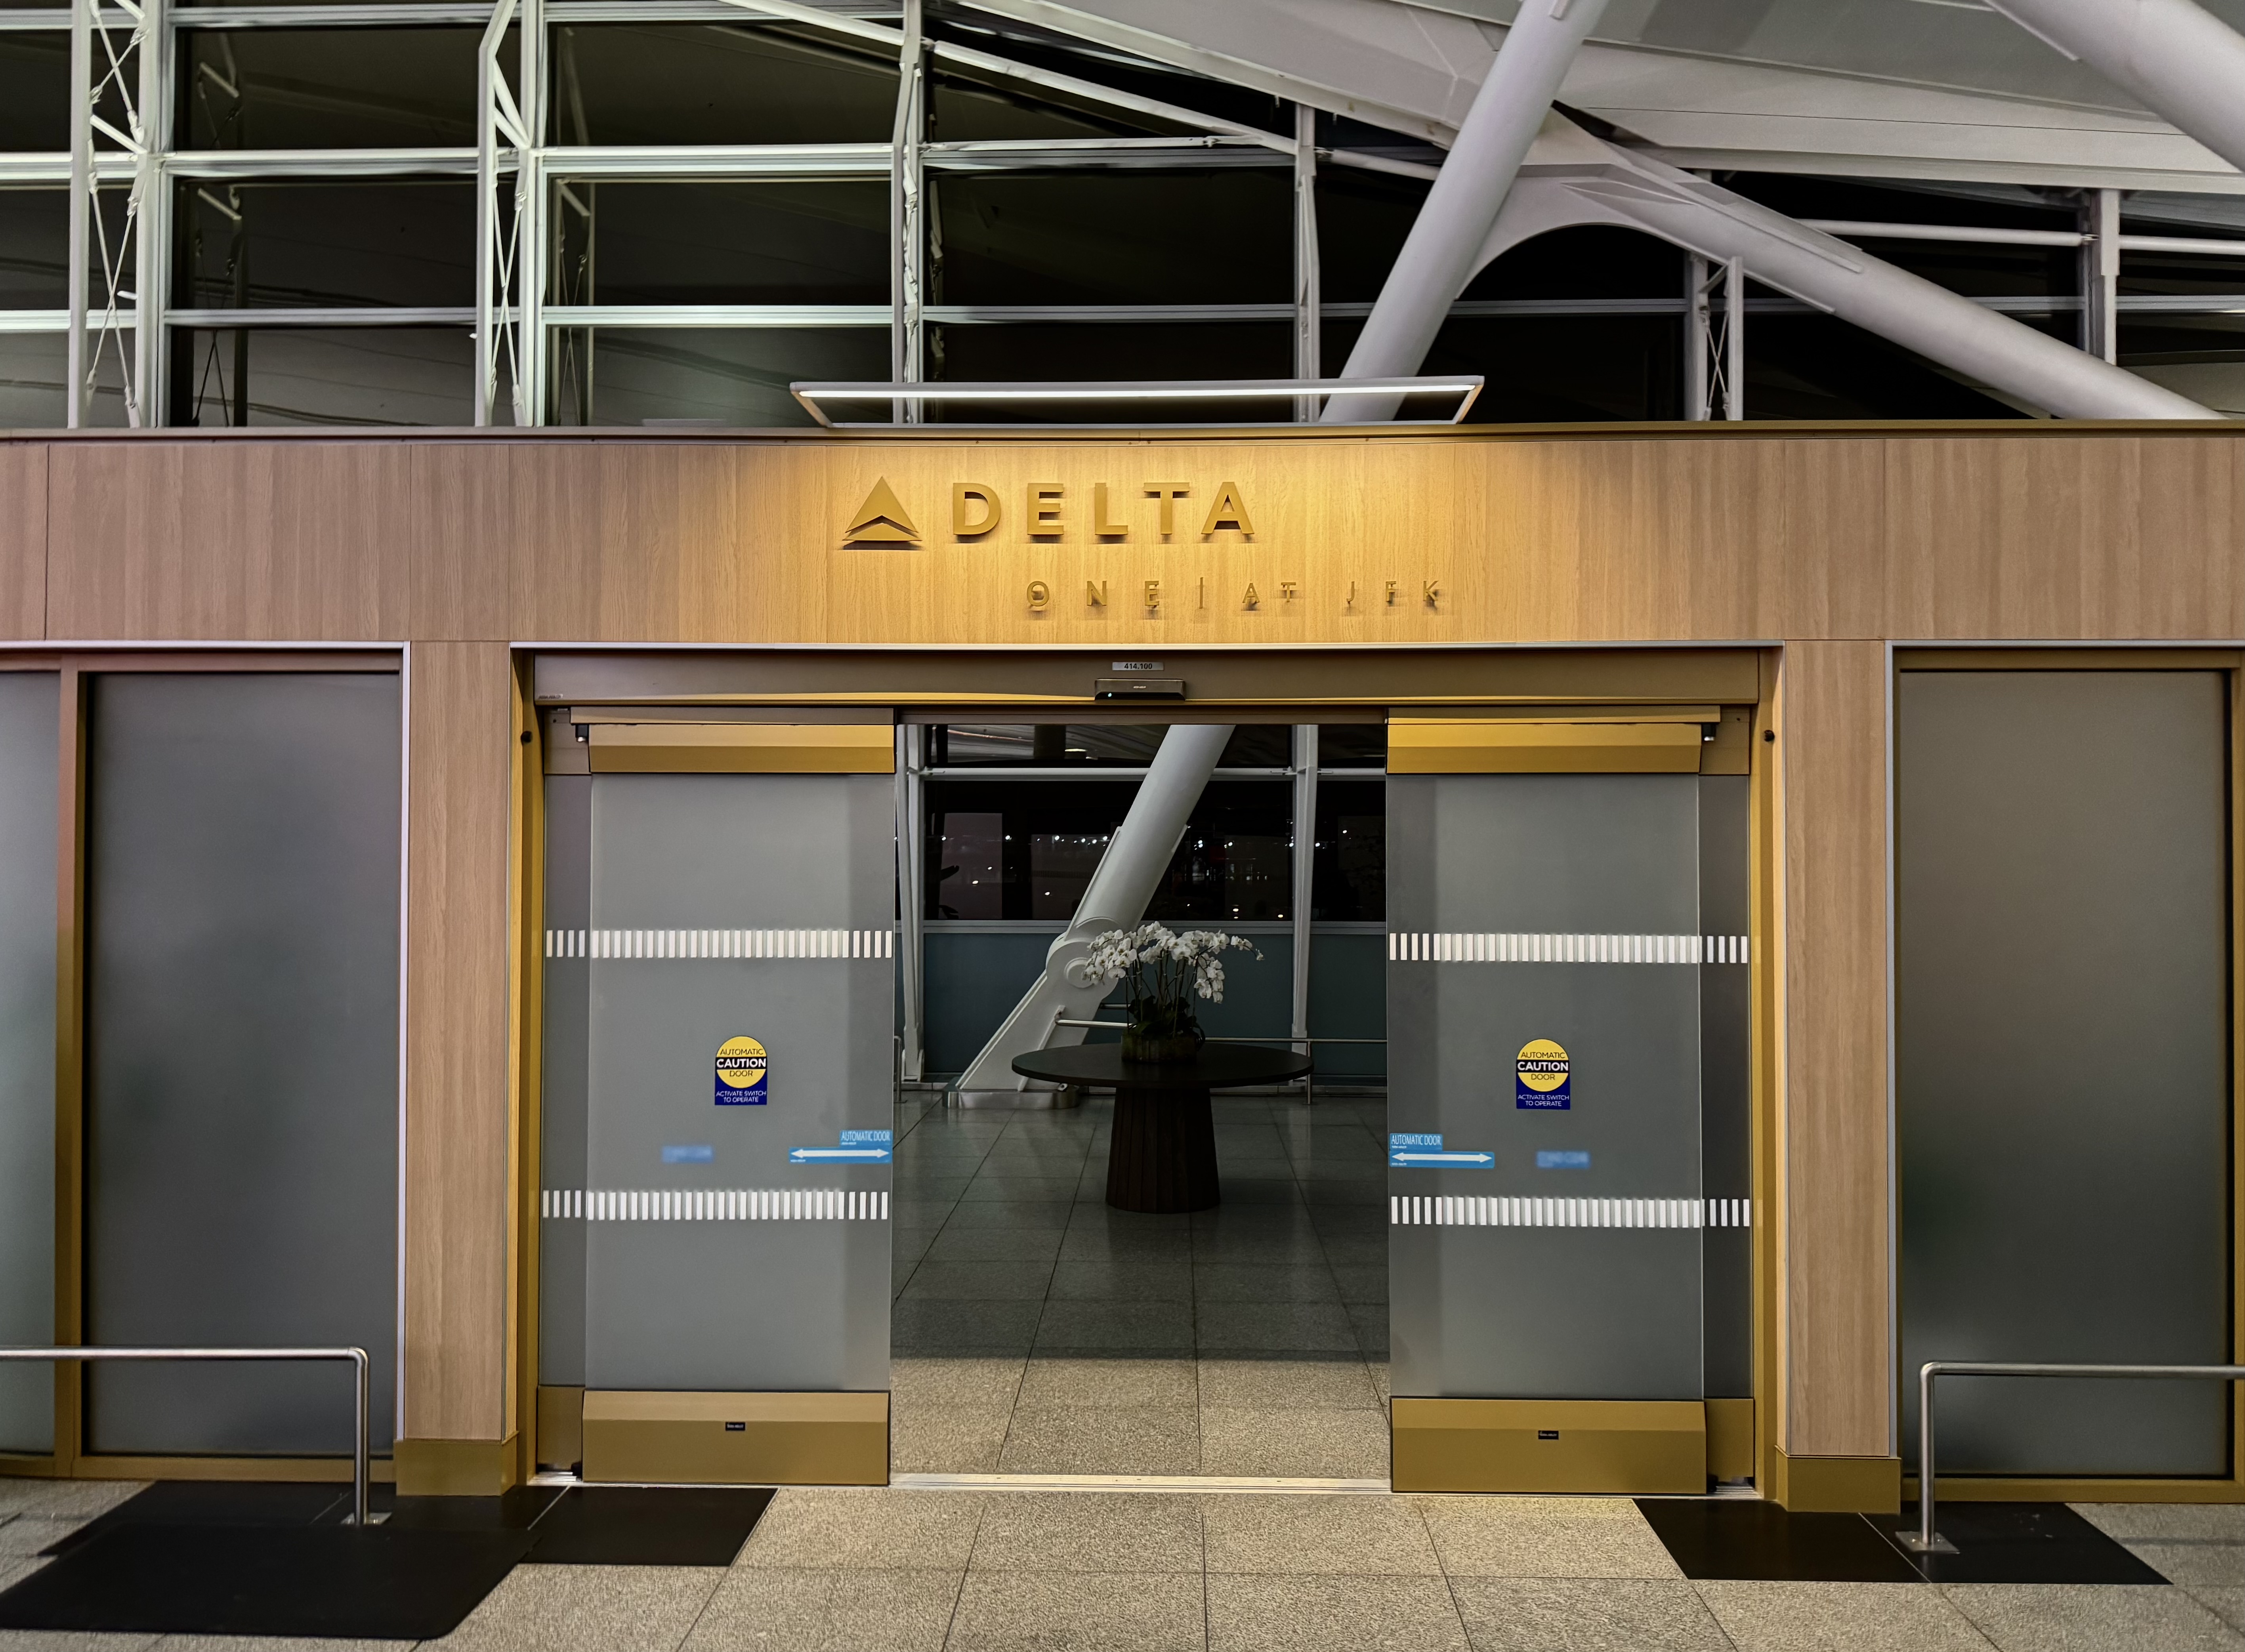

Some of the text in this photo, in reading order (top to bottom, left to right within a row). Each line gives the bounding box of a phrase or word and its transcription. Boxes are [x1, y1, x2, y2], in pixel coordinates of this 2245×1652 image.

[953, 482, 1254, 535] DELTA
[1027, 580, 1160, 607] ONE
[1243, 582, 1296, 603] AT
[1346, 580, 1439, 602] JFK
[716, 1058, 767, 1068] CAUTION
[1517, 1061, 1569, 1071] CAUTION
[841, 1130, 890, 1141] AUTOMATIC DOOR
[1392, 1135, 1441, 1145] AUTOMATIC DOOR
